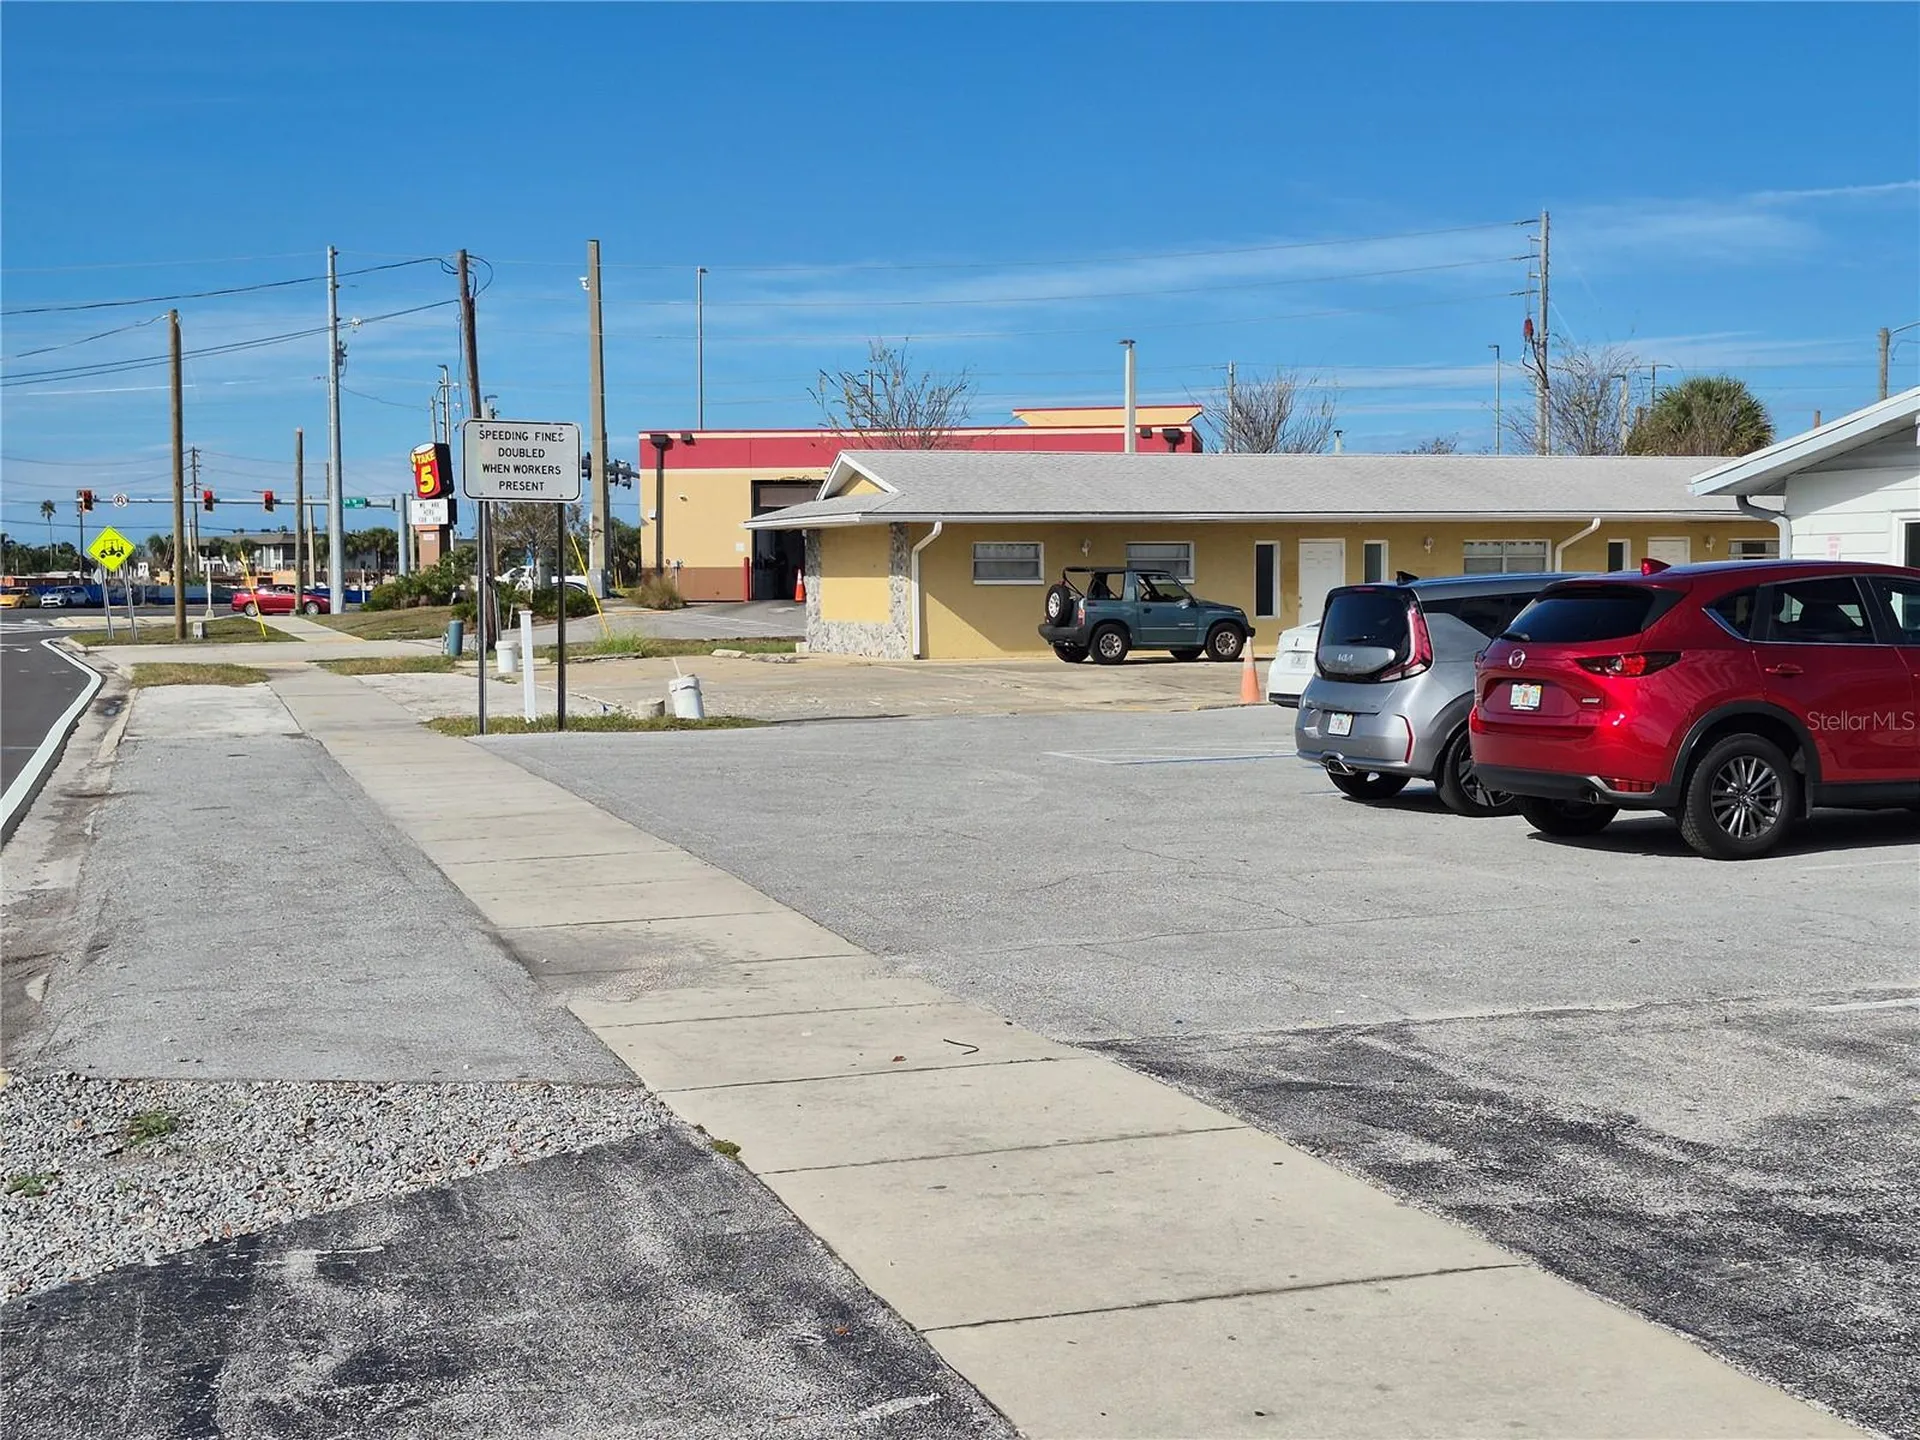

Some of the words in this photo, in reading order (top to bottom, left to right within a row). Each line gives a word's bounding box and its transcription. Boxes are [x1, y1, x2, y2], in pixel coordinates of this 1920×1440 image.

[479, 430, 529, 441] SPEEDING
[535, 432, 565, 442] FINES
[416, 450, 436, 465] TAKE
[498, 448, 545, 458] DOUBLED
[482, 463, 510, 473] WHEN
[513, 464, 561, 475] WORKERS
[420, 465, 434, 493] 5
[499, 481, 545, 491] PRESENT
